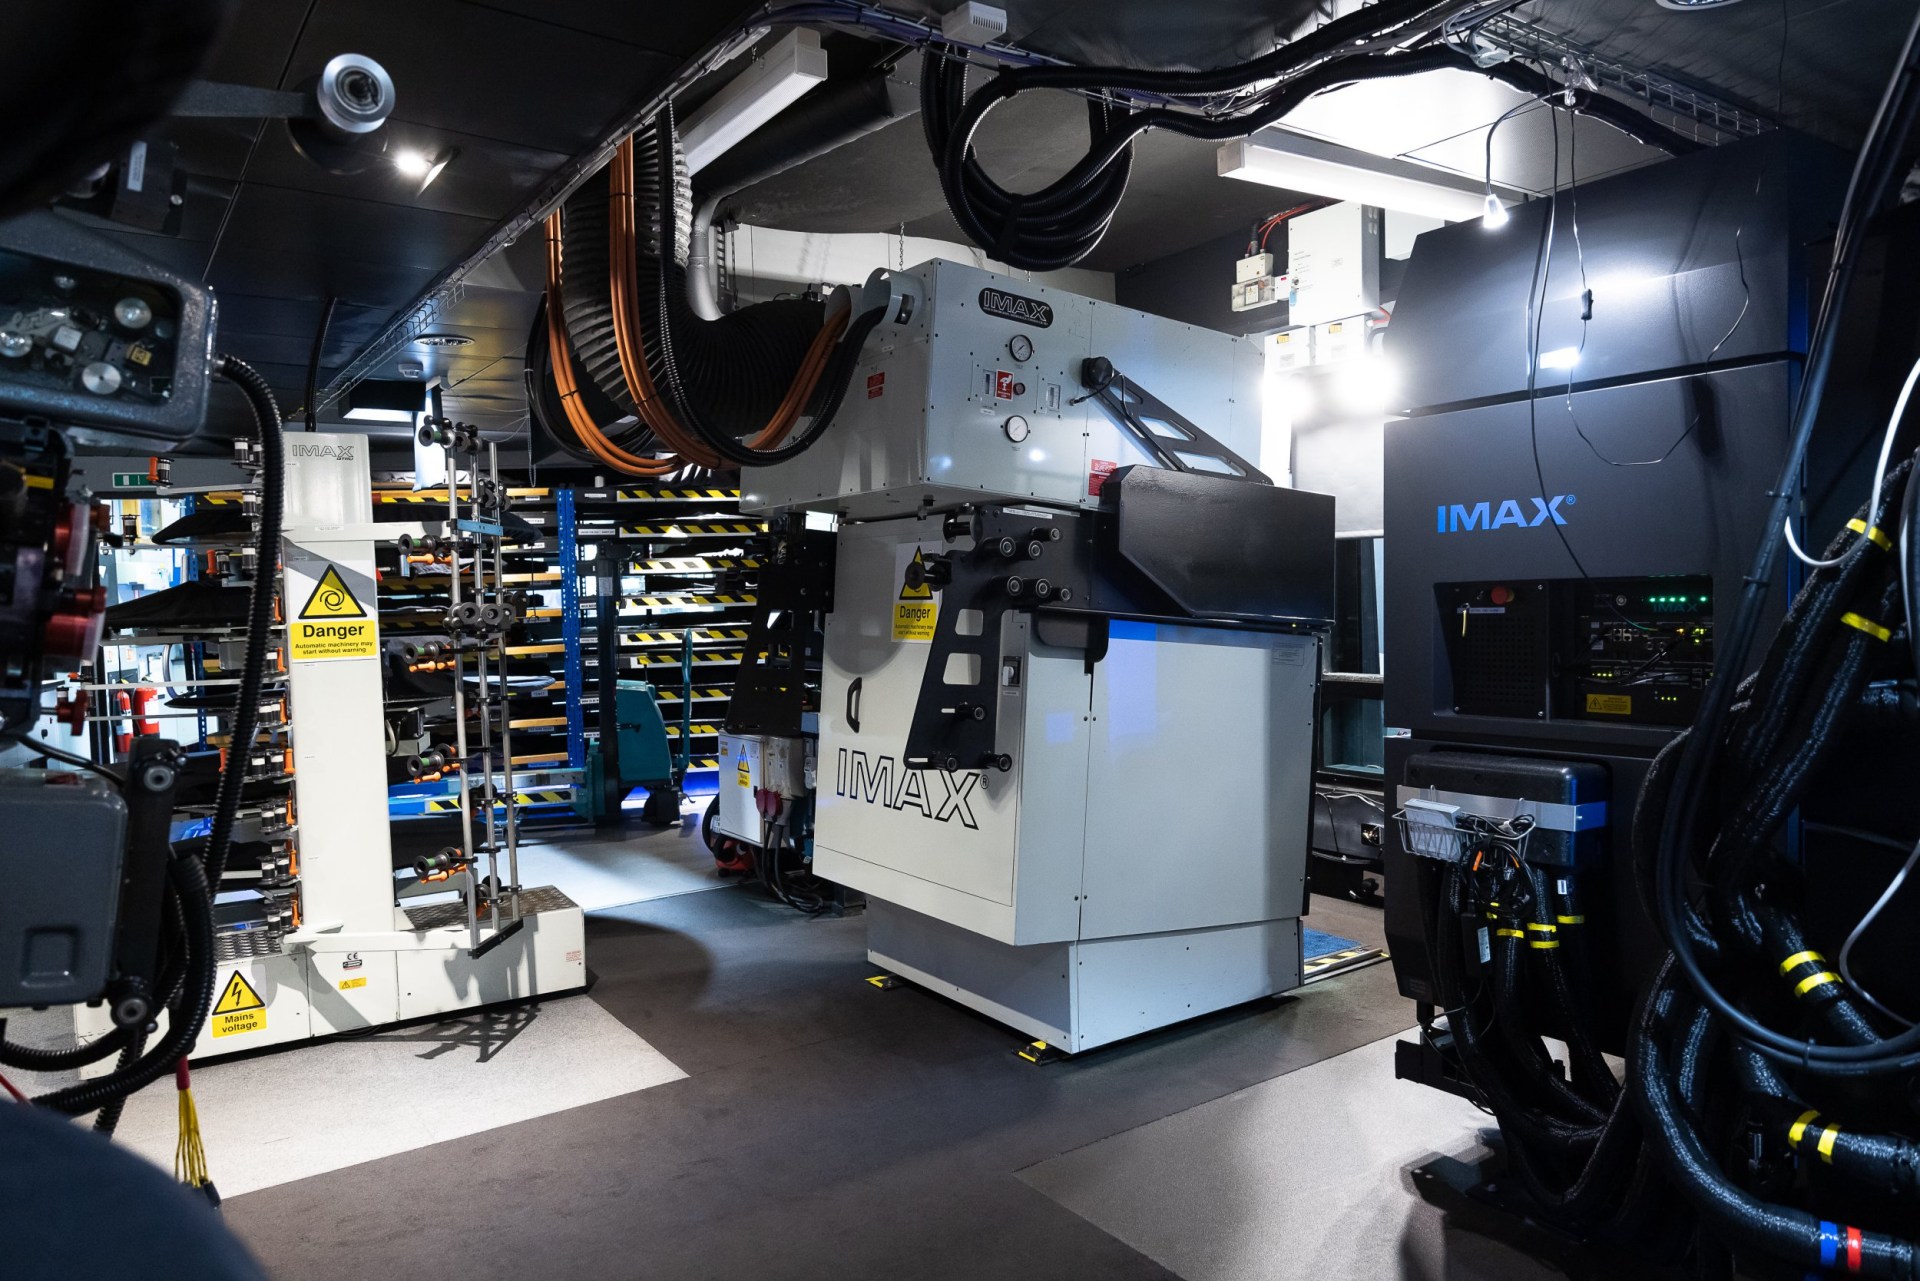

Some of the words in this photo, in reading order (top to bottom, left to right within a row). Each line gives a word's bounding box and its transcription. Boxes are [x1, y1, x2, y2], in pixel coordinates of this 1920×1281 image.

[983, 290, 1047, 322] IMAX
[292, 445, 354, 458] IMAX
[900, 606, 930, 621] Danger
[1653, 603, 1698, 613] IMAX
[303, 625, 364, 640] Danger
[224, 1013, 254, 1024] Mains
[222, 1021, 258, 1033] voltage
